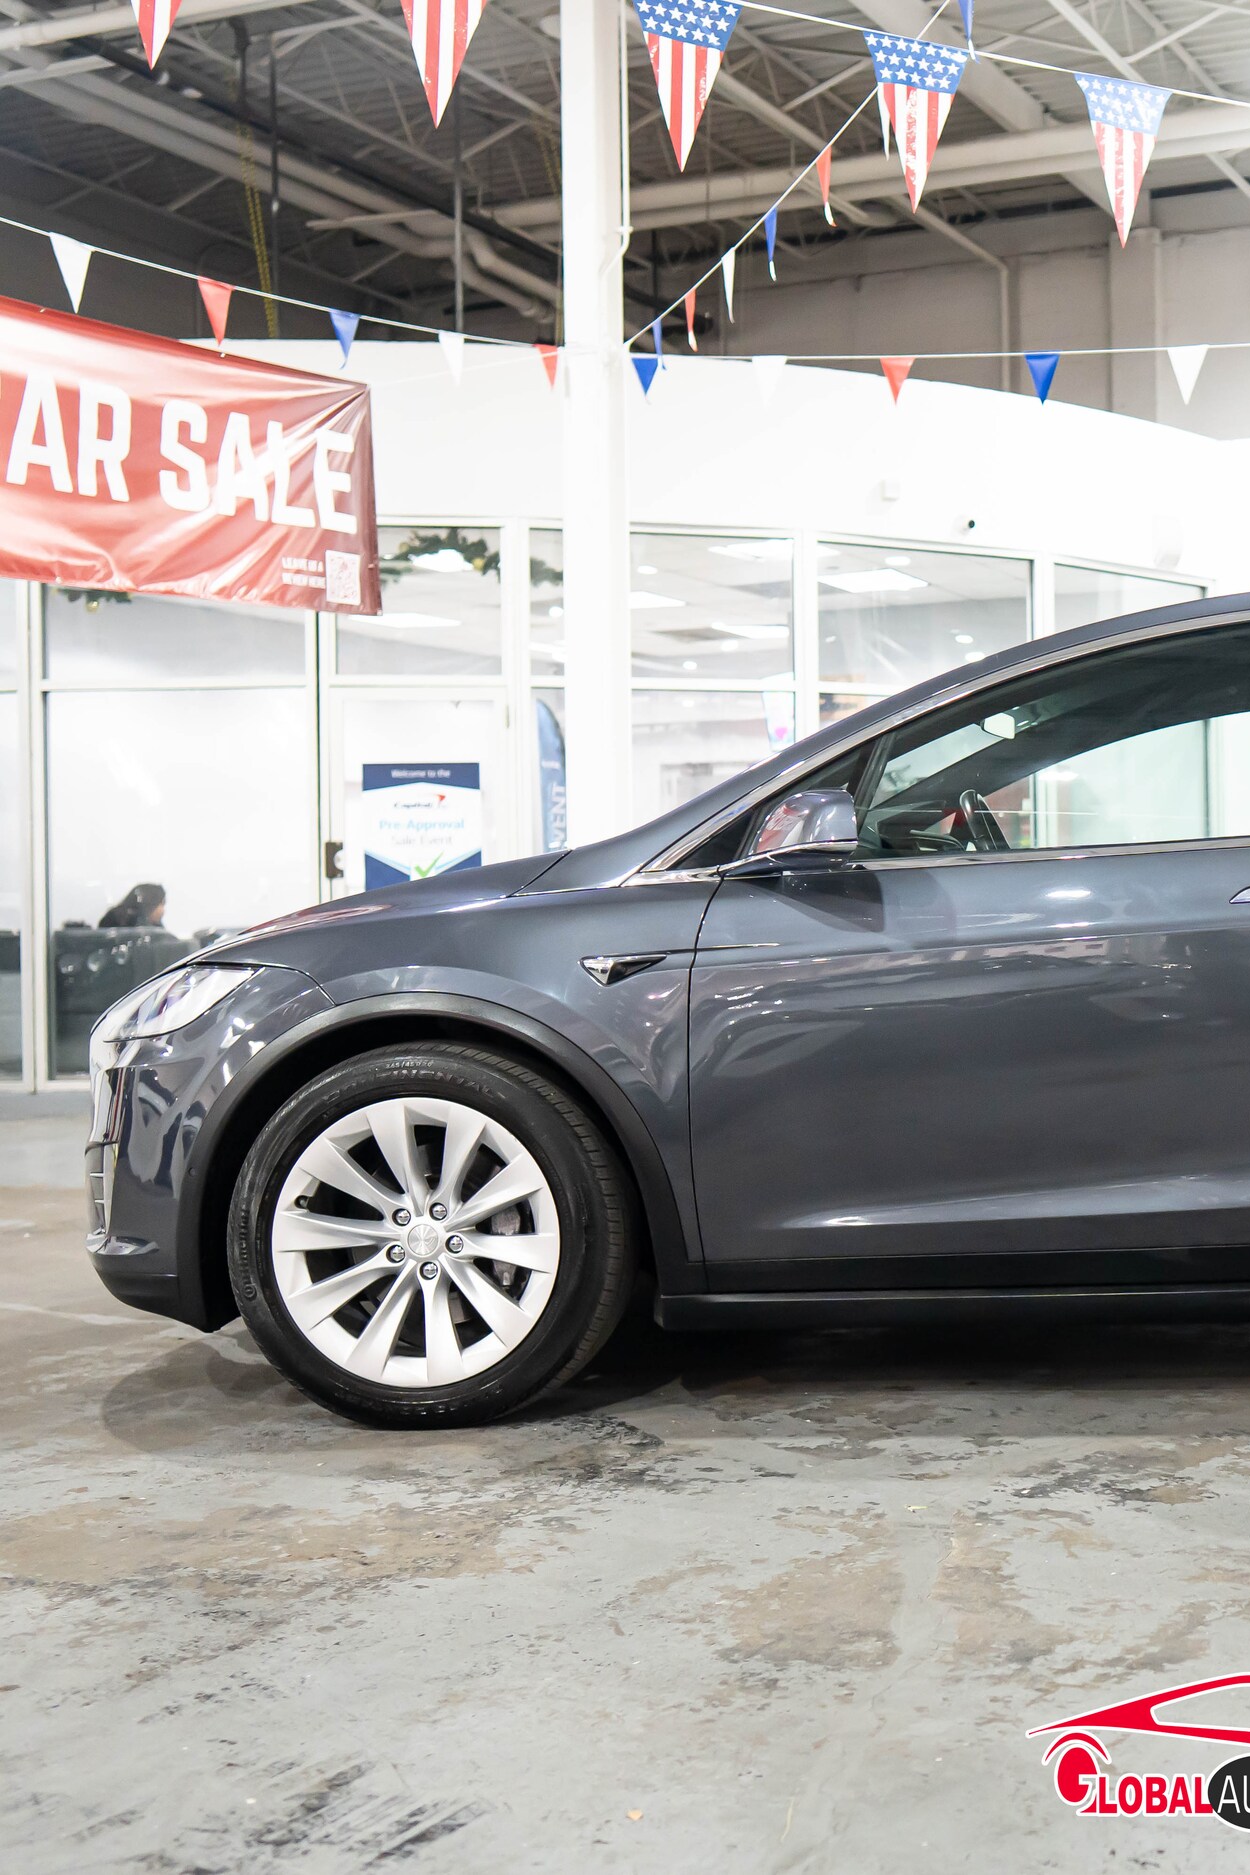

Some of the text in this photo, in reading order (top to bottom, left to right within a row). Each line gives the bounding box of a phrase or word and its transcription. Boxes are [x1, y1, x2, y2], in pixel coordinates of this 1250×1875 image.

[0, 371, 358, 535] AR SALE
[391, 768, 451, 779] Welcome to the
[379, 818, 465, 832] Pre-Approval
[391, 835, 453, 846] Sale Event
